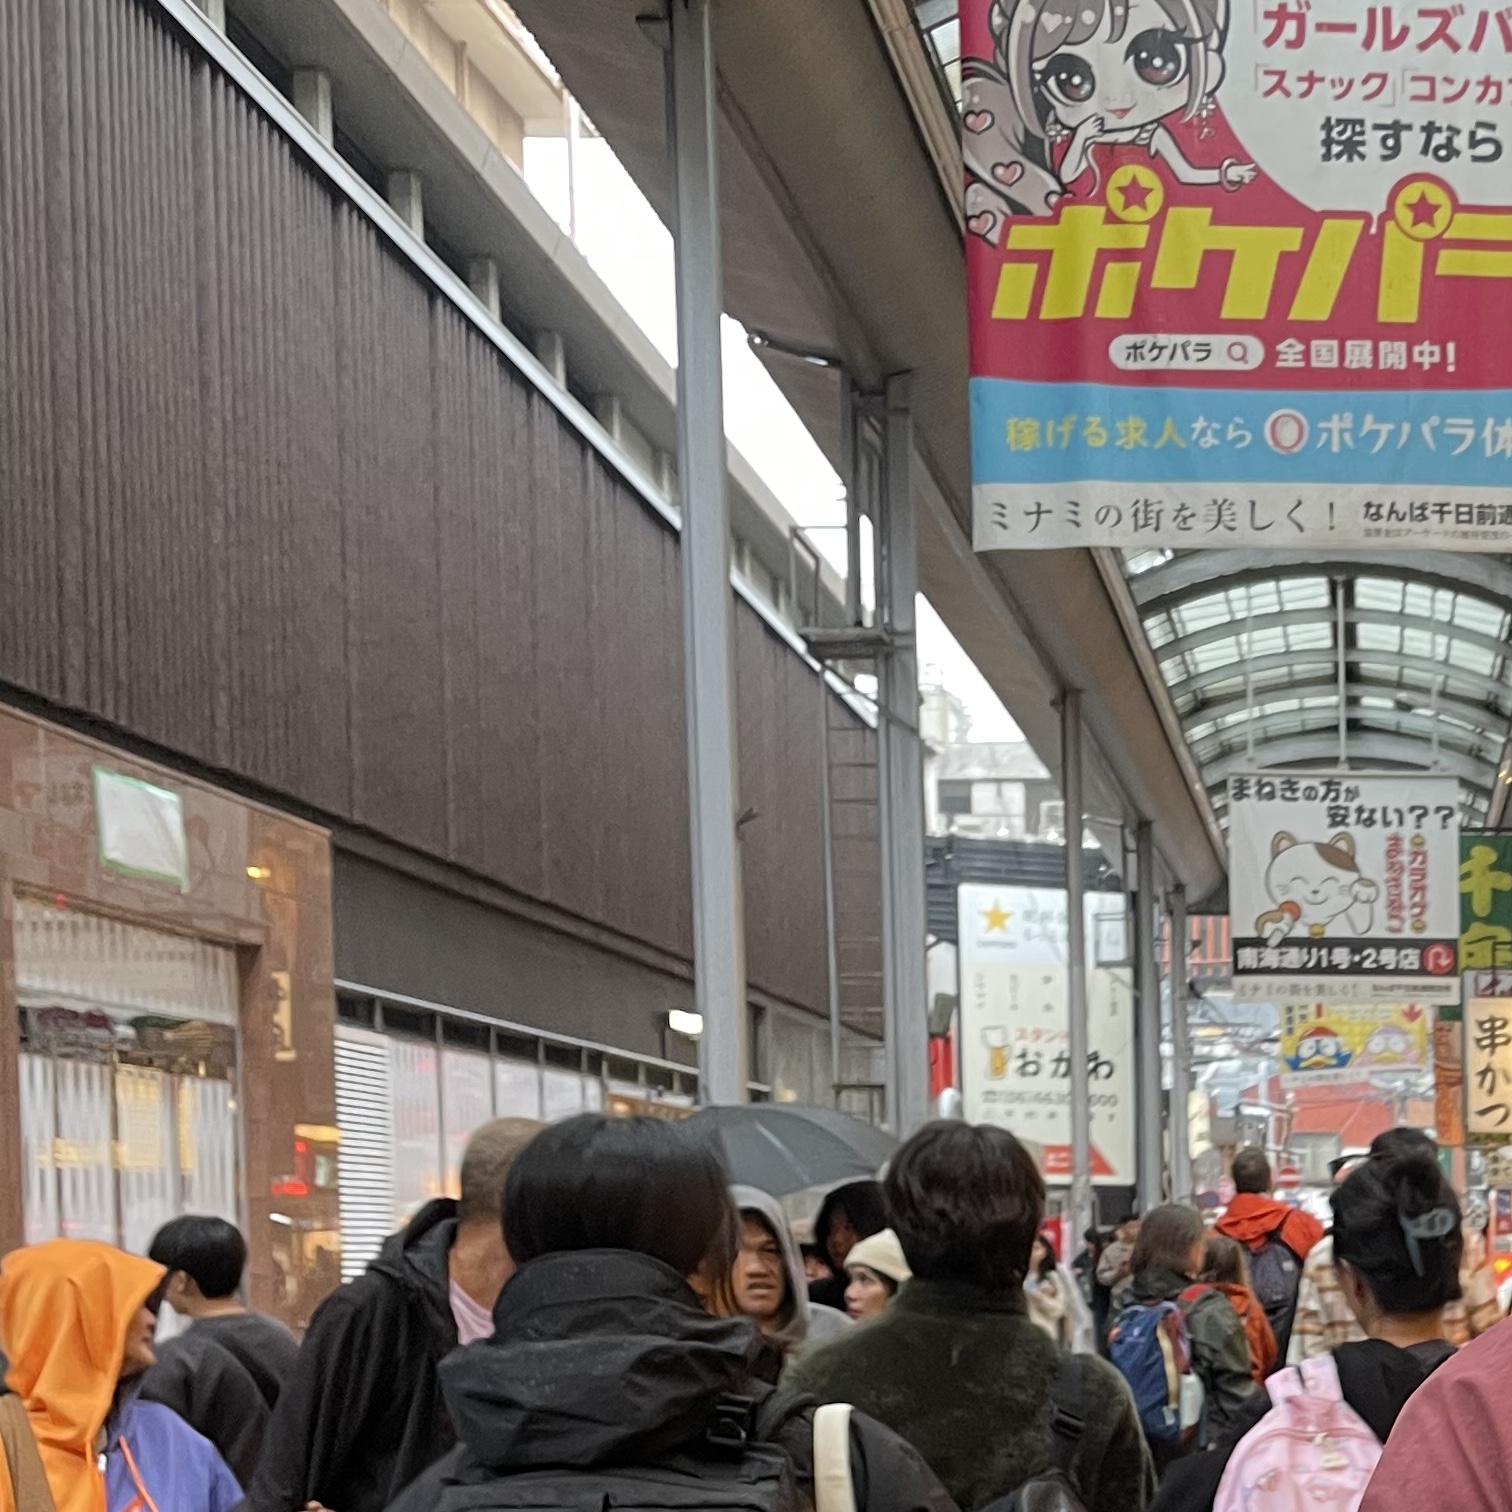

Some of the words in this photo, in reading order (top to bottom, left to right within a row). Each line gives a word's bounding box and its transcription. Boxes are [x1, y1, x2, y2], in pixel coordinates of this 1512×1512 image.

[1320, 116, 1504, 163] 探すなら
[1125, 341, 1212, 365] ポケパラ
[1275, 339, 1457, 372] 全国展開中!
[989, 497, 1337, 533] ミナミの街を美しく！
[1231, 778, 1361, 802] まねきの方が
[1410, 850, 1428, 917] カラオケ
[1473, 1014, 1512, 1128] 串かつ
